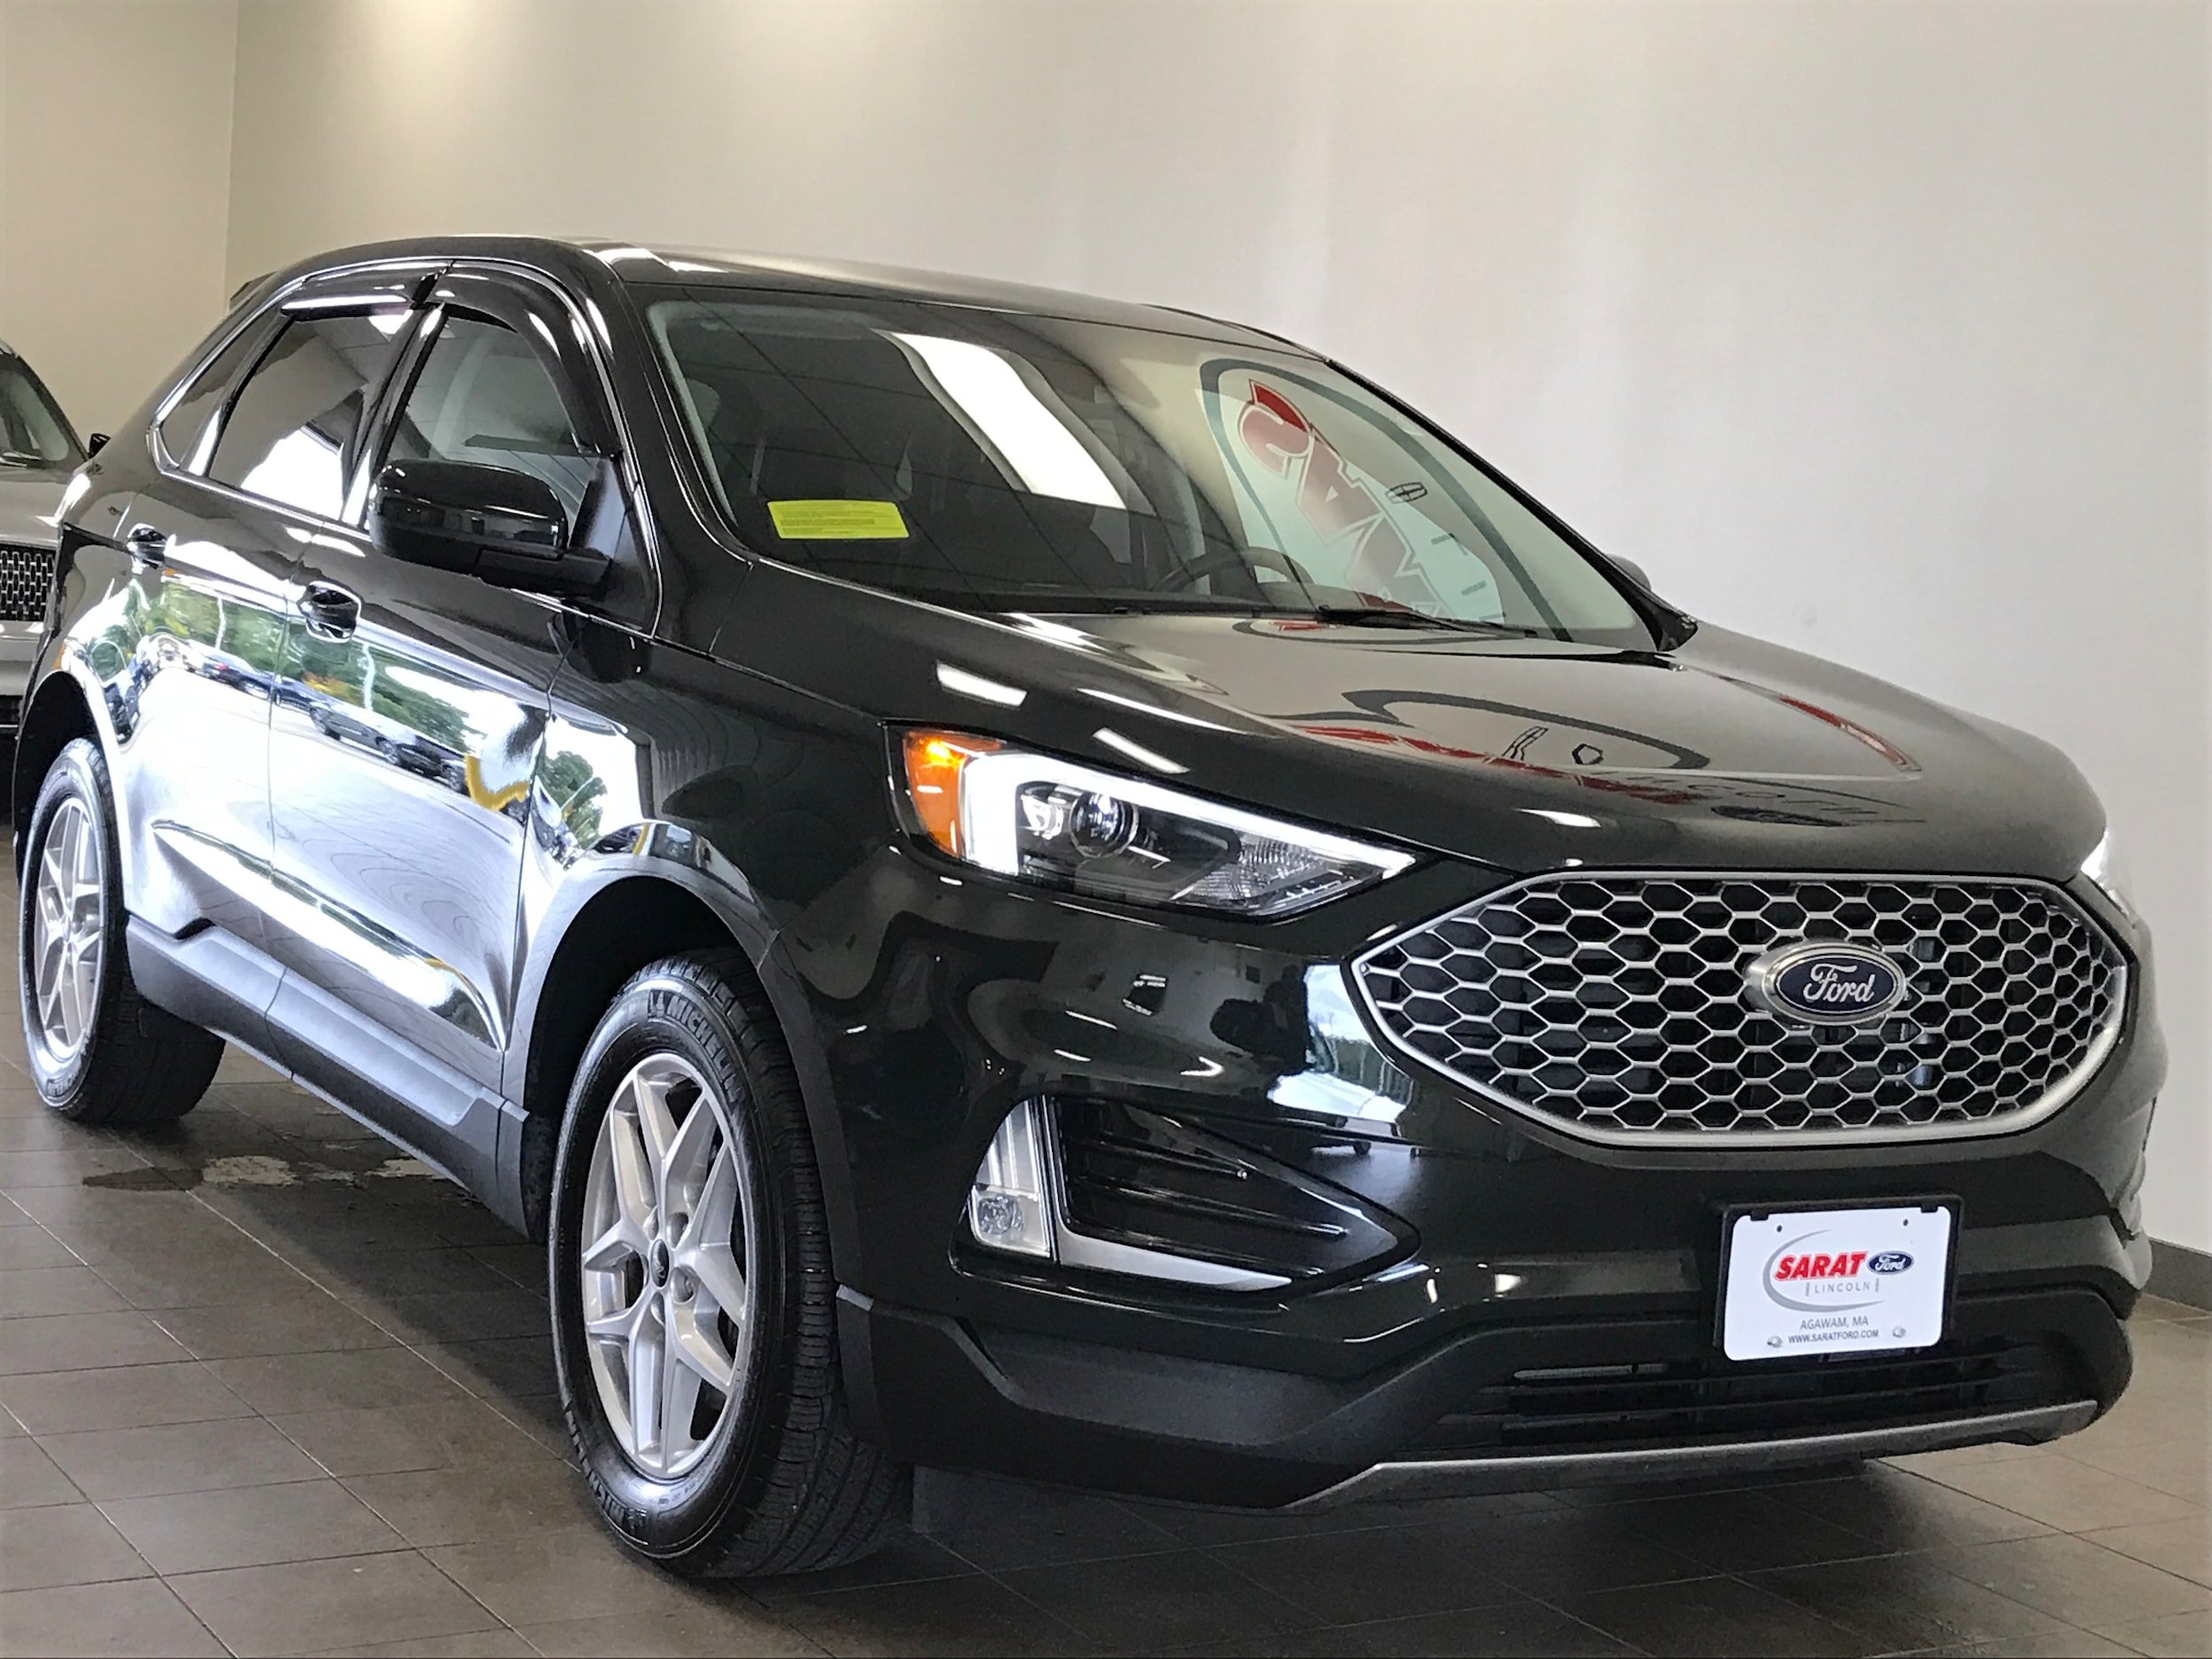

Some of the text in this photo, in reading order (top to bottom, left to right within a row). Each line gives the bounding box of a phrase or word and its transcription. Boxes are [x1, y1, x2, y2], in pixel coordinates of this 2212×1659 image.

[1802, 963, 1877, 1003] Ford
[666, 994, 743, 1103] MICHELIN
[1774, 1251, 1906, 1281] SARAT Ford
[1814, 1281, 1870, 1294] LINCOLN
[1800, 1315, 1869, 1330] AGAWAM, MA
[1788, 1329, 1879, 1343] WWW.SARATFORD.COM
